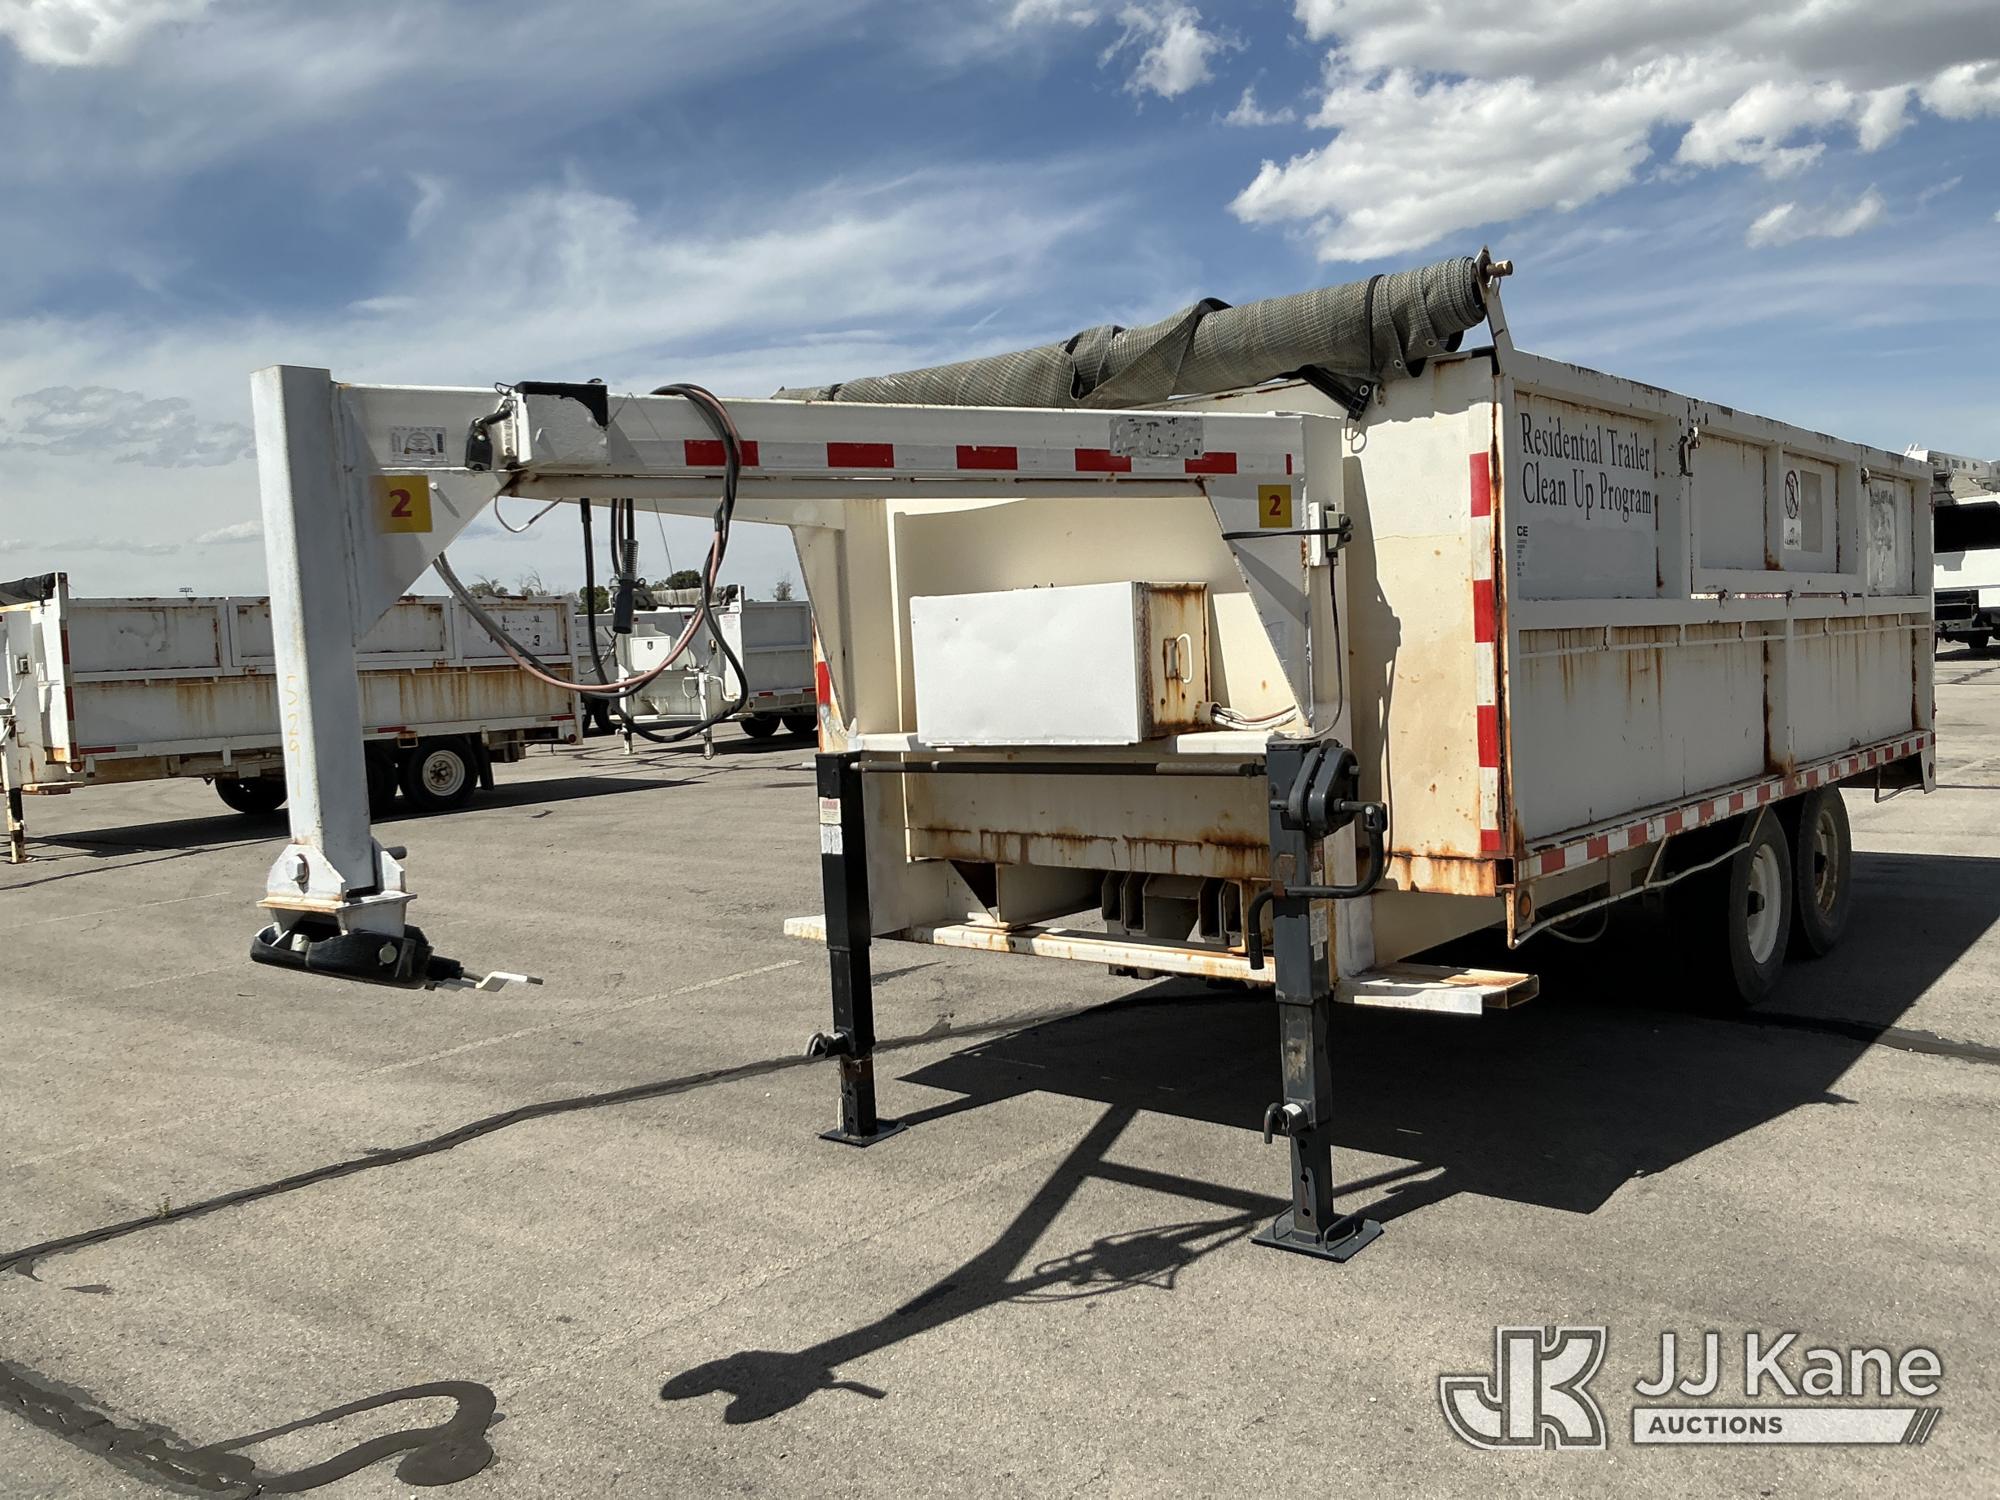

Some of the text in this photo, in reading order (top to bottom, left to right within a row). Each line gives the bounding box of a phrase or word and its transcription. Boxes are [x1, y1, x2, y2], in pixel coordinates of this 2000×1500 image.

[1520, 412, 1650, 472] Residential Trailer
[389, 488, 413, 518] 2
[1269, 494, 1282, 516] 2
[1522, 460, 1652, 523] Clean Up Program
